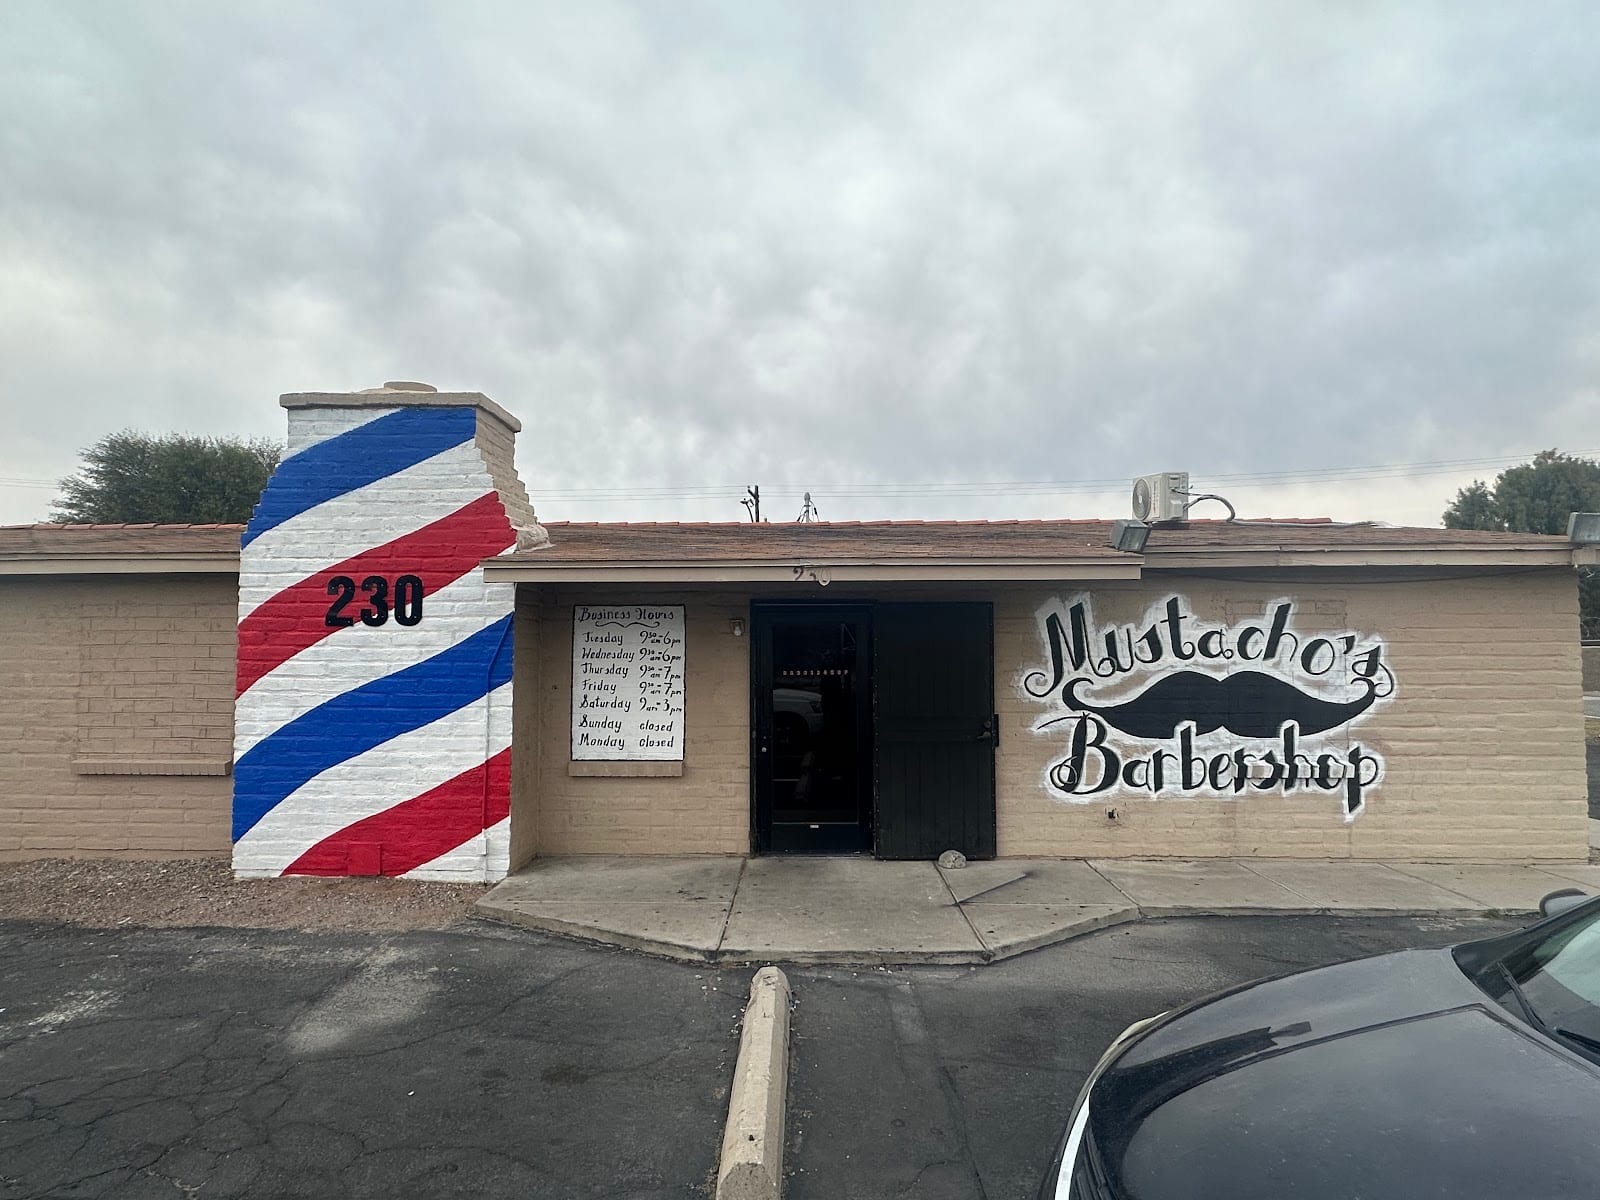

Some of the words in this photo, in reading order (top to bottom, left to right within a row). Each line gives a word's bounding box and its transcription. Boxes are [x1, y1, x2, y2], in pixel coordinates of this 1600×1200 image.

[325, 574, 424, 627] 230
[578, 607, 630, 622] Business
[635, 607, 674, 620] Hours
[582, 631, 624, 645] Tuesday
[1023, 595, 1394, 698] Mustacho's
[581, 647, 635, 662] Wednesday
[580, 662, 629, 678] Thursday
[582, 678, 617, 694] Friday
[579, 694, 631, 712] Saturday
[578, 713, 622, 733] Sunday
[639, 719, 674, 732] closed
[577, 732, 625, 750] Monday
[639, 735, 674, 748] closed
[1036, 711, 1380, 814] Barbershop
